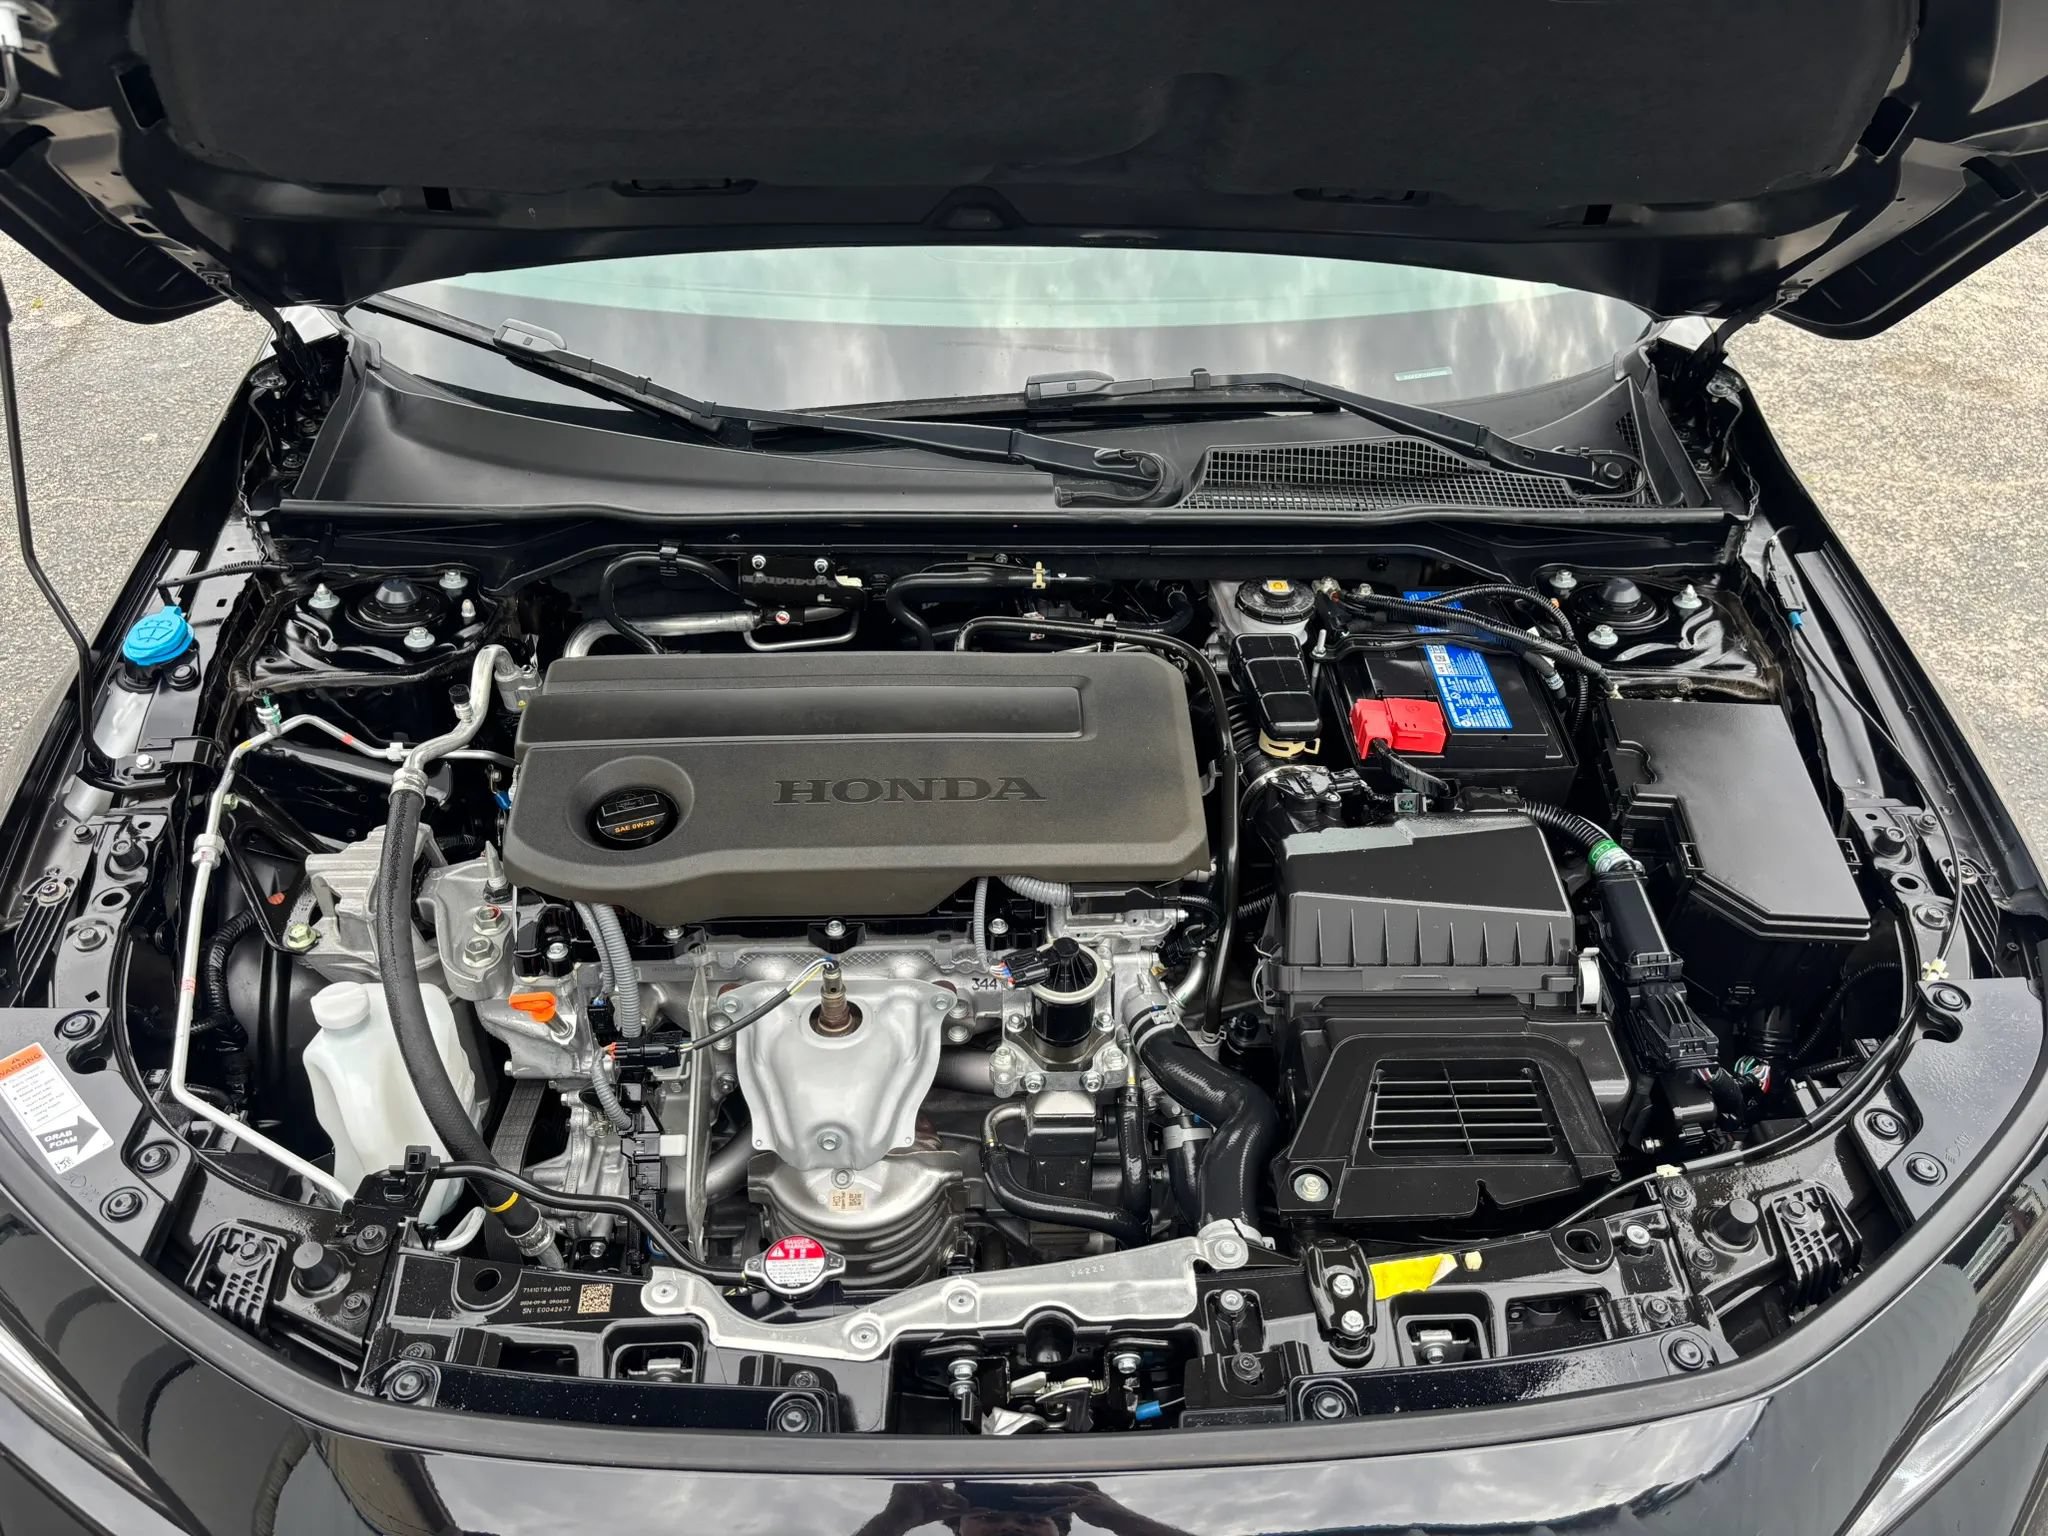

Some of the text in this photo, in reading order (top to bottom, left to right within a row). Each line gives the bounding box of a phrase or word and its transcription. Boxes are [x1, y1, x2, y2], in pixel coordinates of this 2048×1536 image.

[773, 777, 1048, 805] HONDA
[614, 820, 655, 833] SAE 0W-20
[971, 977, 998, 990] 344
[44, 1130, 73, 1143] GRAB
[49, 1136, 78, 1149] FOAM
